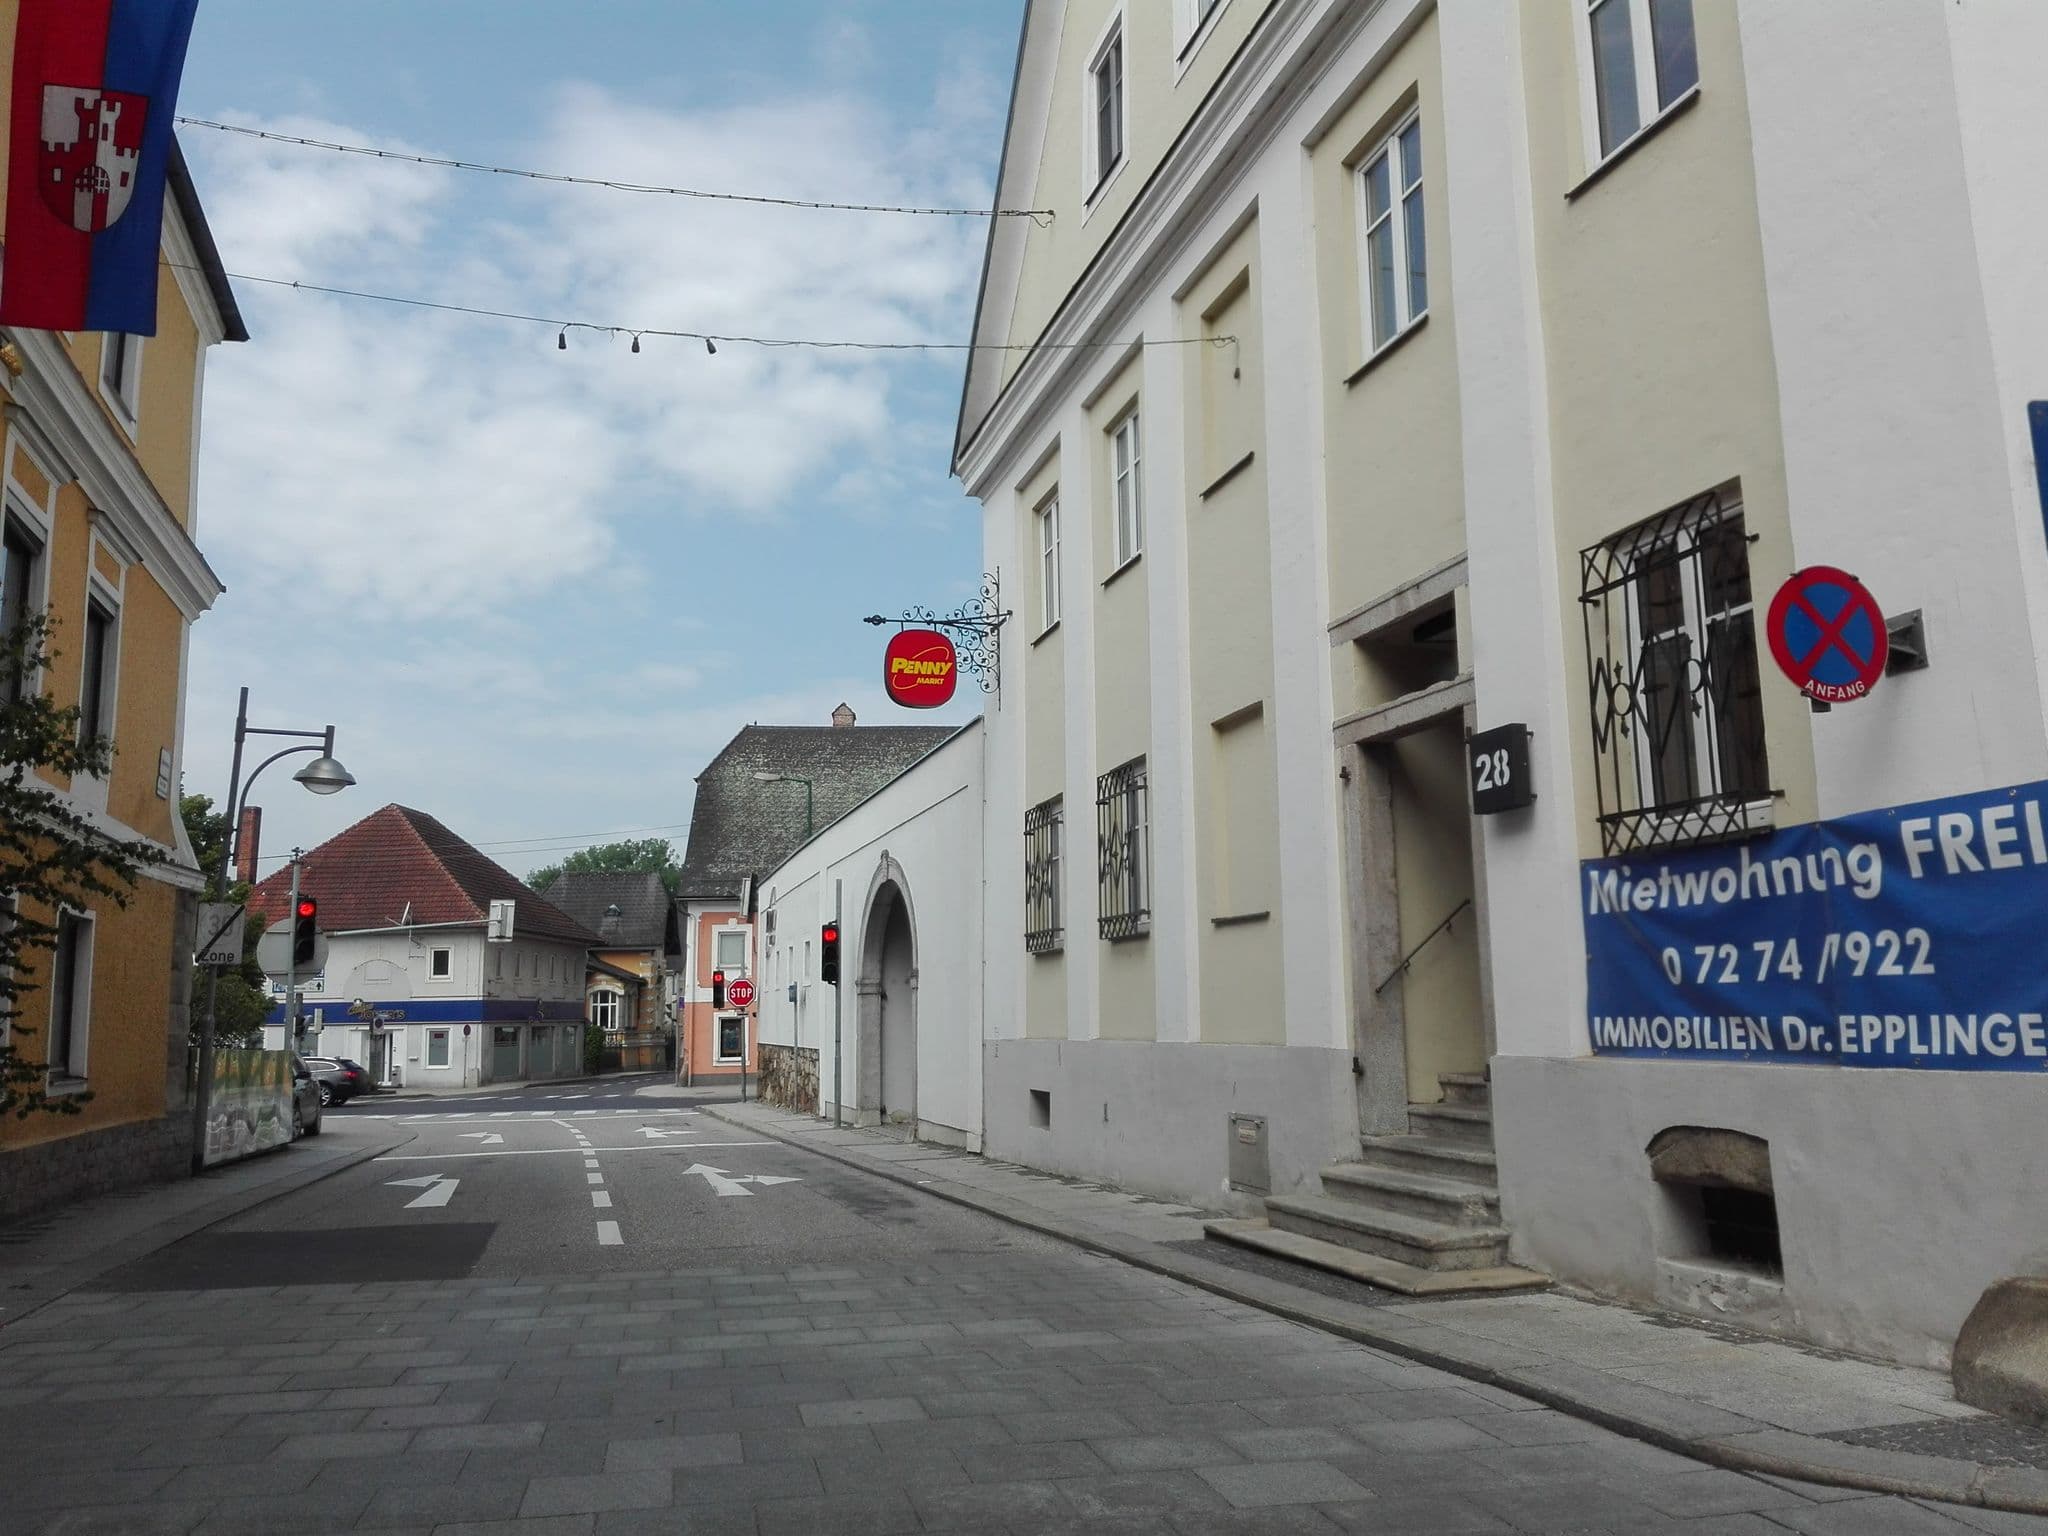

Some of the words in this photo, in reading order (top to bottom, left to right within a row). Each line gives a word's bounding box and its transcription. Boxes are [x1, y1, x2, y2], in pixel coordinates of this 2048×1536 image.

[891, 657, 953, 676] PENNY
[916, 677, 945, 685] MARKT
[1805, 680, 1865, 699] ANFANG
[1476, 748, 1510, 791] 28
[1589, 843, 1882, 915] Mietwohnung
[1901, 800, 2047, 878] FREI
[1662, 946, 1682, 985] 0
[1694, 943, 1739, 984] 72
[1753, 938, 1802, 982] 74
[731, 988, 752, 999] STOP
[1594, 1016, 1773, 1050] IMMOBILIEN
[1782, 1015, 1832, 1052] Dr.
[1839, 1013, 2047, 1057] EPPLINGE
